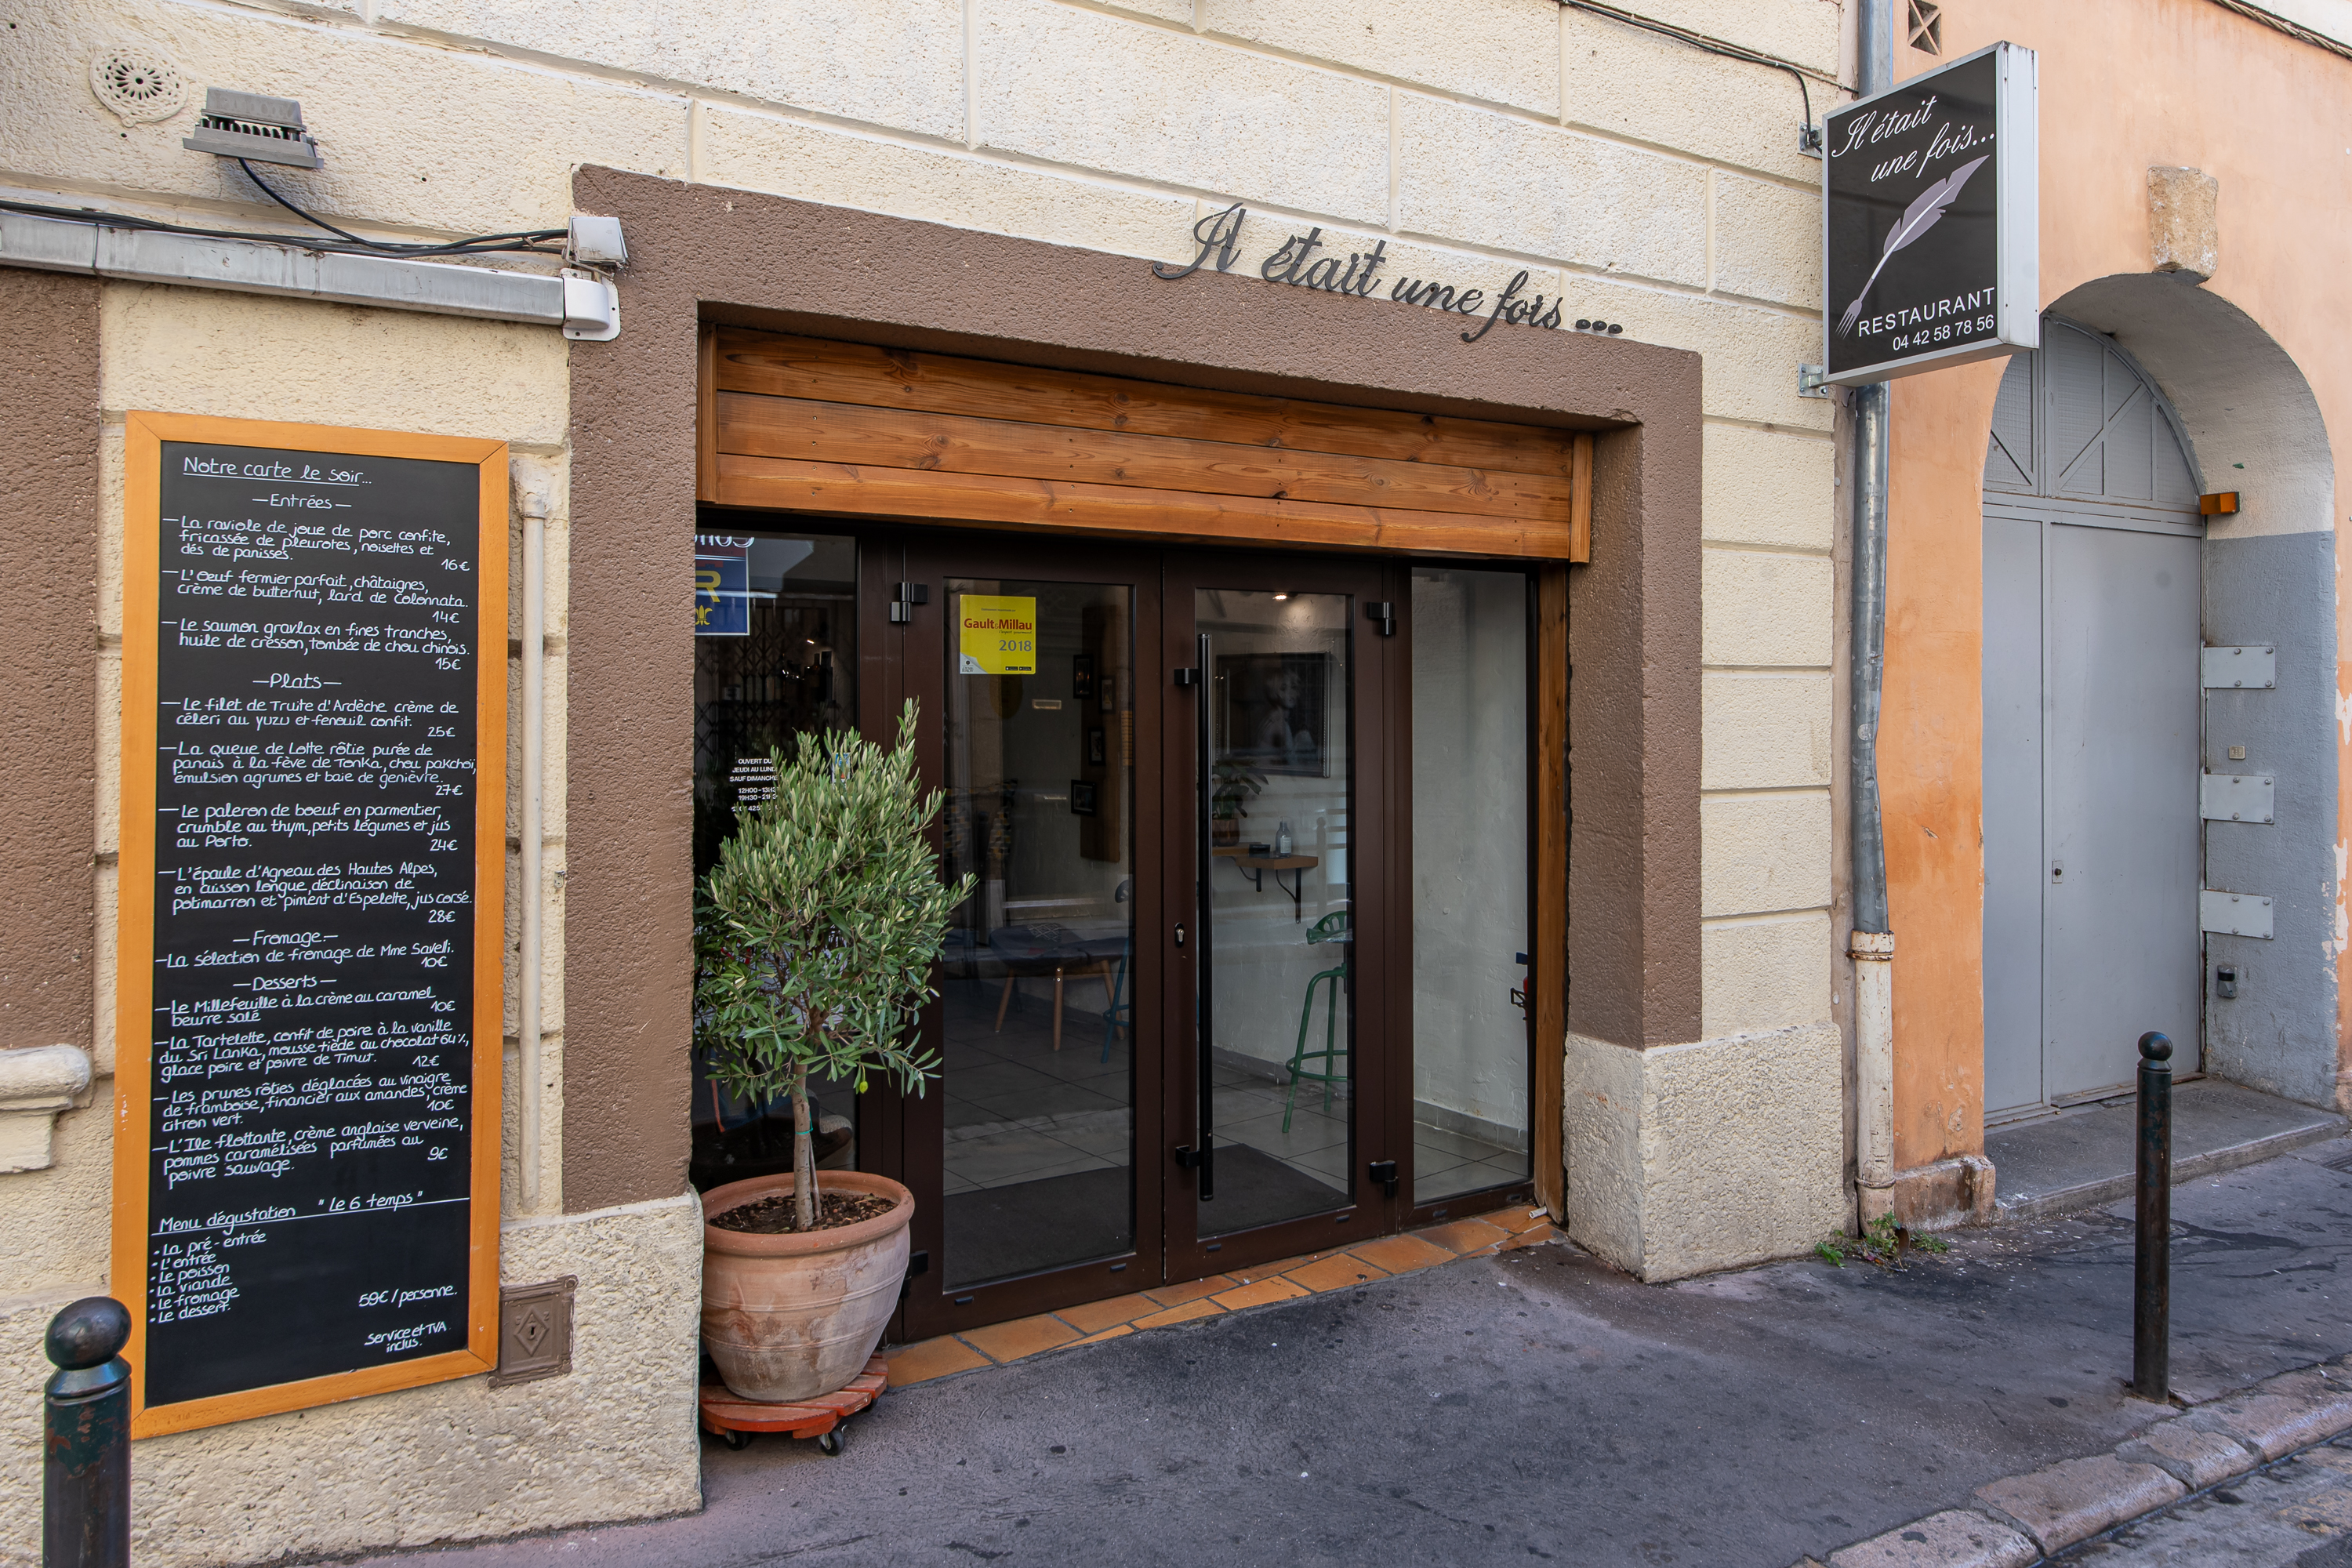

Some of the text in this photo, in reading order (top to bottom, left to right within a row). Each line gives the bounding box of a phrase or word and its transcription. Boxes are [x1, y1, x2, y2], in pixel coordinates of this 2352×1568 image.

[1831, 95, 1937, 158] Il était
[1871, 122, 1994, 183] une fois...
[1152, 201, 1247, 281] Il
[1261, 227, 1387, 298] était
[1391, 275, 1485, 314] une
[1858, 286, 1996, 338] RESTAURANT
[1892, 314, 1994, 351] 04 42 58 78 56
[183, 457, 372, 484] Notre carte le soir...
[270, 493, 332, 509] Entrées
[181, 515, 451, 546] La raviole de joue de porc confite,
[179, 529, 434, 555] fricassée de pleurotes, noisettes et
[180, 543, 293, 562] dés de panisses.
[441, 558, 470, 572] 16€
[432, 611, 459, 623] 14€
[179, 632, 470, 655] huile de cresson, tombée de chou chinois.
[999, 640, 1032, 652] 2018
[435, 657, 461, 670] 15€
[270, 673, 322, 689] Plats
[183, 697, 202, 711] Le
[205, 697, 243, 711] filet
[246, 699, 267, 711] de
[318, 699, 387, 713] d'Ardèche
[394, 700, 434, 713] crème
[440, 702, 459, 713] de
[176, 713, 412, 731] céleri au yuzu et fenouil confit.
[427, 726, 456, 737] 25€
[435, 784, 463, 796] 27€
[176, 819, 451, 838] crumble au thym, petits légumes et jus
[430, 839, 458, 851] 24€
[177, 862, 437, 885] L'épaule d'Agneau des Hautes Alpes,
[174, 877, 415, 898] en cuisson longue, déclinaison de
[428, 910, 456, 923] 28€
[421, 956, 448, 967] 10€
[252, 975, 318, 991] Desserts
[431, 1000, 456, 1012] 10€
[172, 1009, 261, 1027] beurre salé
[170, 1019, 452, 1050] La Tartelette, confit de poire à la vanille
[161, 1053, 376, 1083] glace poire et poivre de Timut.
[412, 1055, 439, 1067] 12€
[172, 1073, 451, 1105] Les prunes rôties déglacées au vinaigre
[163, 1082, 467, 1117] de framboise, financier aux amandes, crème
[427, 1099, 454, 1111] 10€
[162, 1112, 244, 1132] citron vert.
[163, 1135, 424, 1176] pommes caramélisées parfumées au
[427, 1146, 448, 1160] 9€
[159, 1218, 201, 1232] Menu
[206, 1206, 296, 1236] dégustation
[350, 1196, 360, 1210] 6
[158, 1264, 230, 1286] Le poisson
[157, 1274, 233, 1298] La viande
[158, 1288, 240, 1310] Le fromage
[158, 1303, 230, 1323] Le dessert.
[411, 1324, 425, 1337] et
